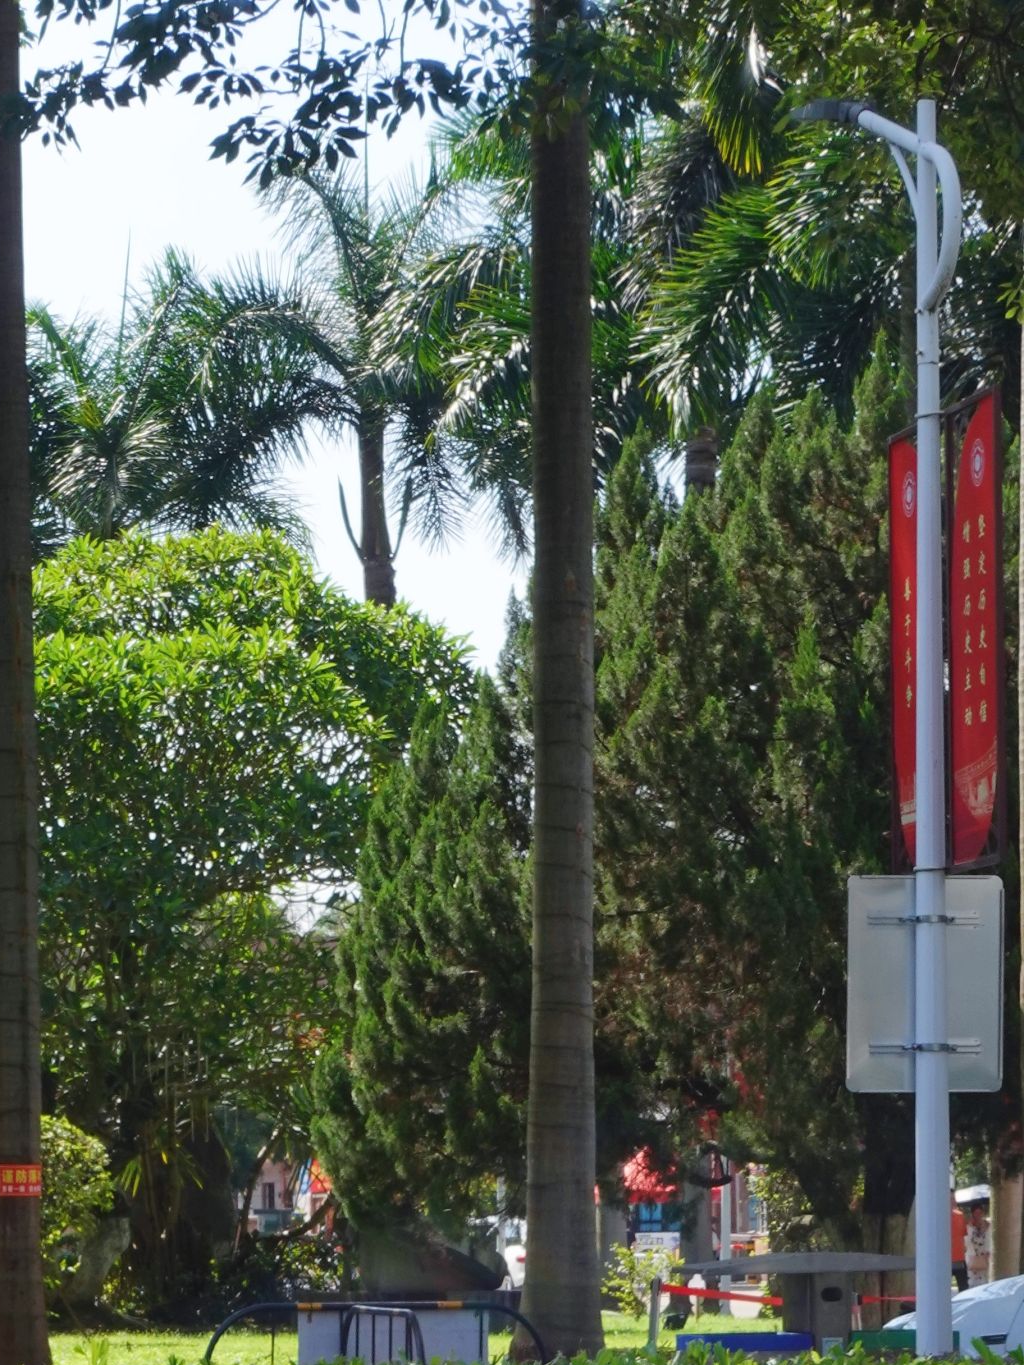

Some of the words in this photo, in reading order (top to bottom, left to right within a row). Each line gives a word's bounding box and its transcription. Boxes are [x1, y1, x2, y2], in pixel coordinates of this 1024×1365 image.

[977, 514, 988, 722] 坚定历史自信
